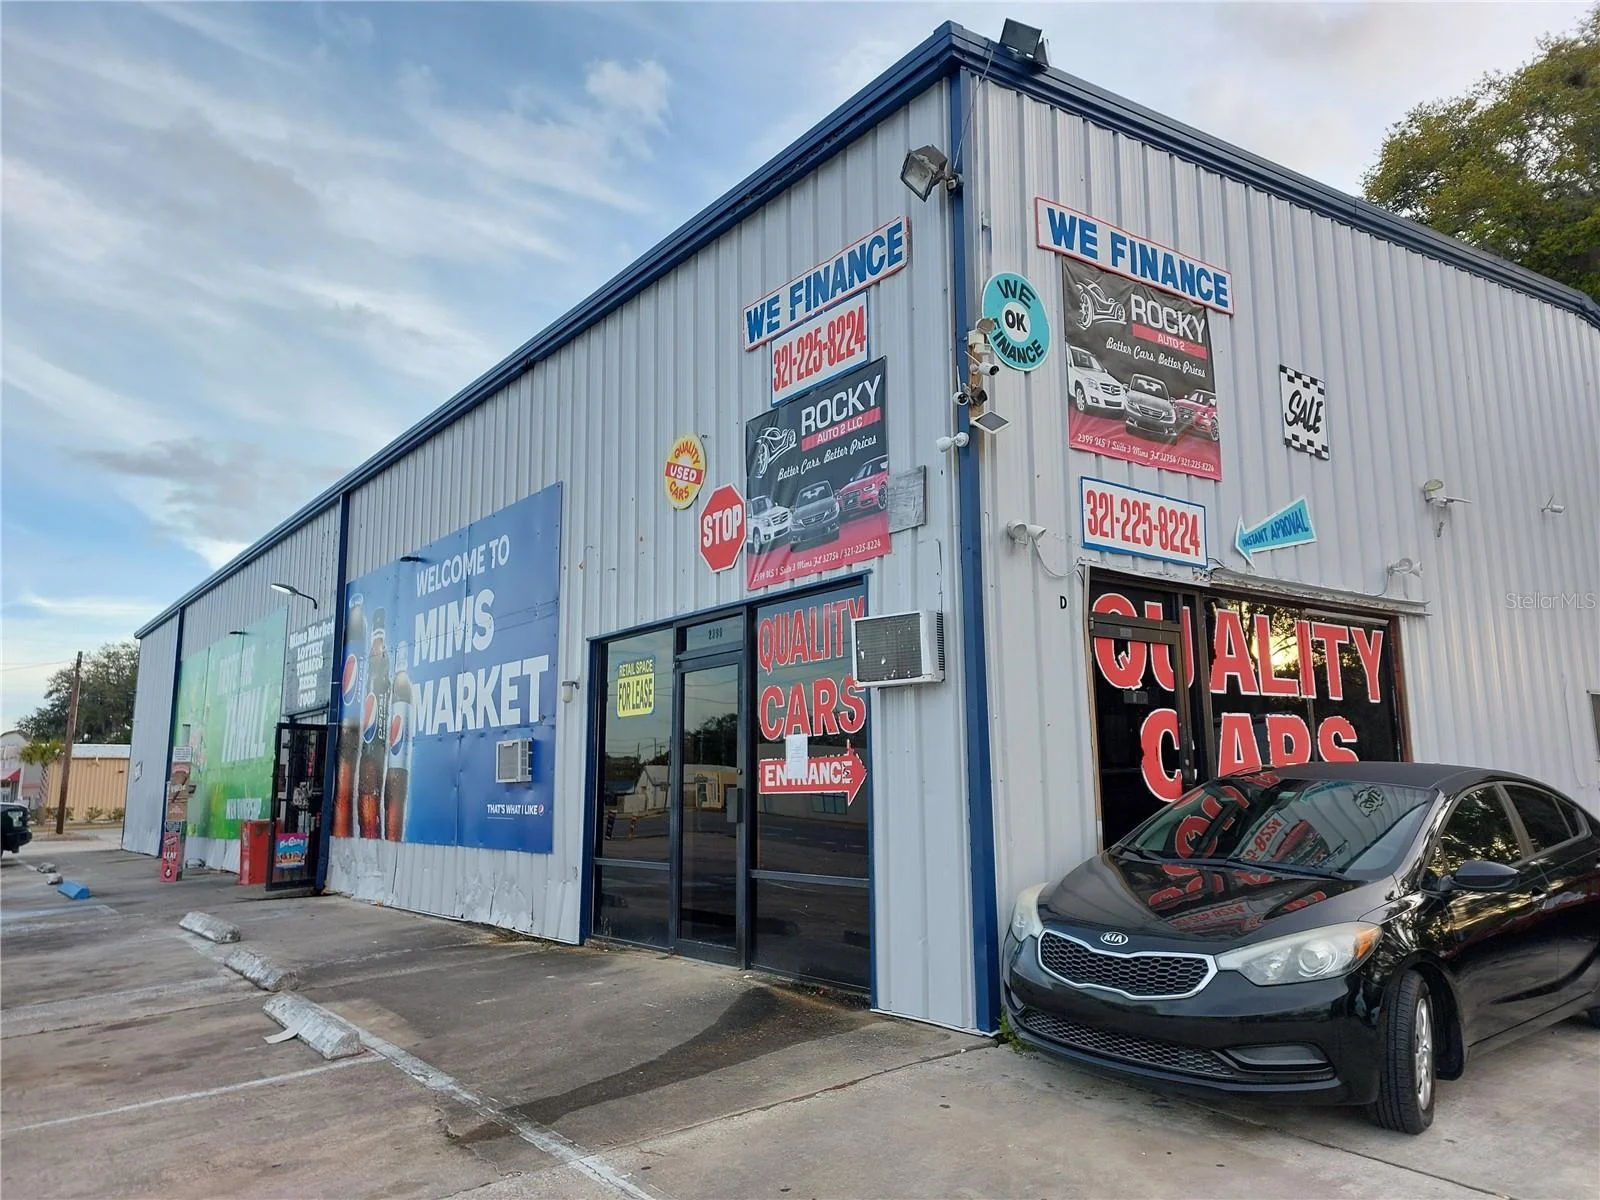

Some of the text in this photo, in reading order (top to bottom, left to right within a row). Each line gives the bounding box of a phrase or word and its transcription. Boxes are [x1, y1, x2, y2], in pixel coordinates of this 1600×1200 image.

[1047, 207, 1229, 308] WE FINANCE
[746, 221, 903, 344] WE FINANCE
[996, 279, 1036, 310] WE
[1004, 309, 1028, 333] OK
[1130, 293, 1206, 344] ROCKY
[773, 305, 866, 392] 321-225-8224
[1105, 336, 1132, 356] Better
[1158, 352, 1182, 372] Better
[1182, 360, 1206, 378] Prices
[1157, 333, 1185, 352] AUTO 2
[801, 374, 882, 436] ROCKY
[1284, 389, 1324, 435] SALE
[674, 440, 701, 465] QUALITY
[816, 416, 864, 446] AUTO 2 LLC
[1077, 433, 1095, 445] 2399
[670, 465, 697, 482] USED
[777, 464, 800, 482] Better
[823, 446, 849, 463] Better
[849, 434, 878, 455] Prices
[669, 480, 690, 501] CARS
[703, 504, 743, 548] STOP
[1086, 489, 1201, 557] 321-225-8224
[1242, 508, 1309, 548] INSTANT APROVAL
[415, 533, 511, 598] WELCOME TO
[1059, 595, 1068, 610] D
[413, 588, 496, 667] MIMS
[757, 595, 866, 674] QUALITY
[1091, 592, 1385, 704] QUALITY
[619, 659, 653, 678] RETAIL SPACE
[413, 654, 549, 736] MARKET
[618, 677, 653, 712] FOR LEASE
[759, 673, 867, 741] CARS
[764, 760, 853, 787] ENANCE
[1140, 708, 1359, 802] CARS
[487, 804, 505, 815] THAT'S
[505, 804, 521, 815] WHAT
[524, 805, 538, 815] LIKE
[1103, 933, 1124, 943] KIA
